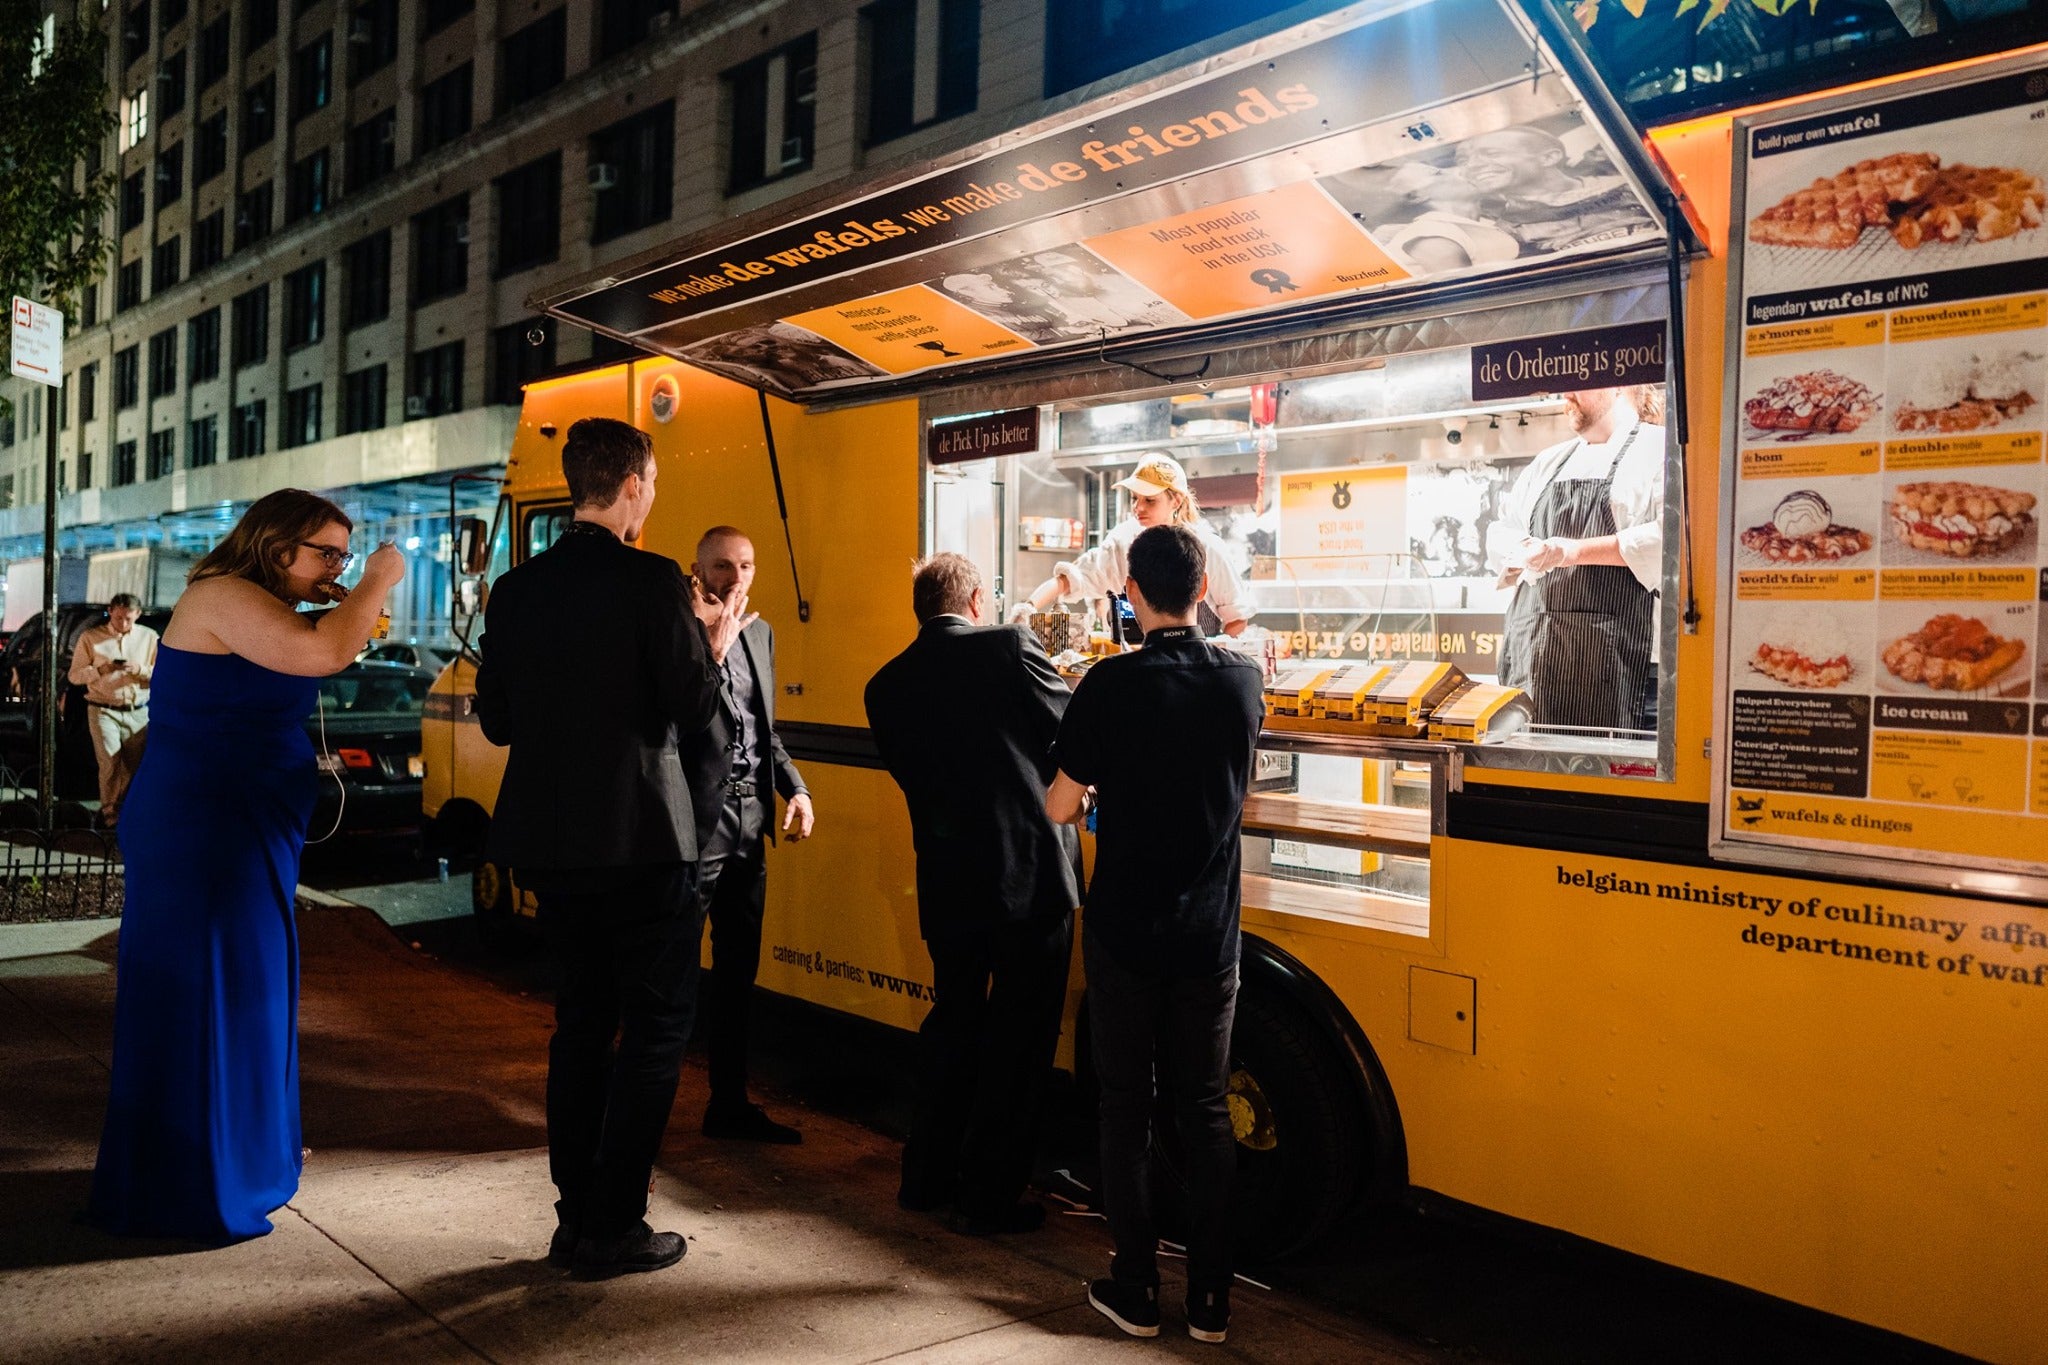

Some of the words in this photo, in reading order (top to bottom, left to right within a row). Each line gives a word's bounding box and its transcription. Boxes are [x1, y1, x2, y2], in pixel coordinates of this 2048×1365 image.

[1757, 134, 1782, 151] build
[1783, 131, 1804, 148] your
[1805, 128, 1826, 141] own
[1828, 112, 1881, 136] wafel
[648, 289, 679, 304] we
[678, 274, 735, 297] make
[719, 259, 776, 283] de
[764, 218, 918, 269] wafels,
[902, 203, 950, 228] we
[941, 179, 1024, 217] make
[1016, 160, 1088, 193] de
[1080, 82, 1321, 173] friends
[1149, 224, 1198, 244] Most
[1199, 208, 1262, 236] popular
[1182, 237, 1224, 256] food
[1224, 226, 1271, 247] truck
[1200, 257, 1222, 271] in
[1222, 250, 1251, 267] the
[1250, 242, 1290, 261] USA
[1752, 300, 1807, 321] legendary
[1809, 289, 1884, 313] wafels
[1886, 287, 1901, 302] of
[1901, 282, 1929, 301] NYC
[851, 321, 877, 332] most
[877, 312, 922, 331] favorite
[1892, 306, 1981, 325] throwdown
[872, 329, 907, 344] waffle
[908, 324, 939, 341] place
[1480, 353, 1501, 383] de
[1506, 343, 1590, 381] Ordering
[1593, 340, 1609, 372] is
[1614, 332, 1665, 377] good
[939, 433, 951, 454] de
[953, 428, 973, 452] Pick
[975, 426, 990, 453] Up
[991, 424, 1000, 446] is
[1001, 423, 1030, 445] better
[1899, 441, 1950, 454] double
[1754, 453, 1783, 462] bom
[1319, 521, 1338, 535] USA
[1739, 573, 1789, 584] world's
[1791, 573, 1817, 583] fair
[1918, 572, 1965, 584] maple
[1977, 572, 2025, 583] bacon
[1163, 629, 1187, 638] SONY
[1350, 631, 1387, 659] de
[1390, 633, 1437, 659] make
[1441, 633, 1466, 654] we
[1735, 696, 1773, 707] Shipped
[1774, 698, 1832, 709] Everywhere
[1880, 704, 1908, 718] ice
[1910, 707, 1969, 722] cream
[1734, 740, 1780, 751] Catering?
[1780, 743, 1811, 752] events
[1818, 745, 1859, 756] parties?
[1771, 808, 1829, 824] wafels
[1833, 813, 1847, 826] &
[1851, 814, 1913, 833] dinges
[1556, 865, 1652, 896] belgian
[1657, 880, 1782, 917] ministry
[1788, 897, 1822, 919] of
[1824, 903, 1967, 942] culinary
[773, 944, 813, 974] catering
[814, 951, 824, 973] &
[825, 957, 865, 984] parties:
[1741, 923, 1931, 970] department
[1936, 953, 1972, 976] of
[1979, 962, 2048, 987] waf
